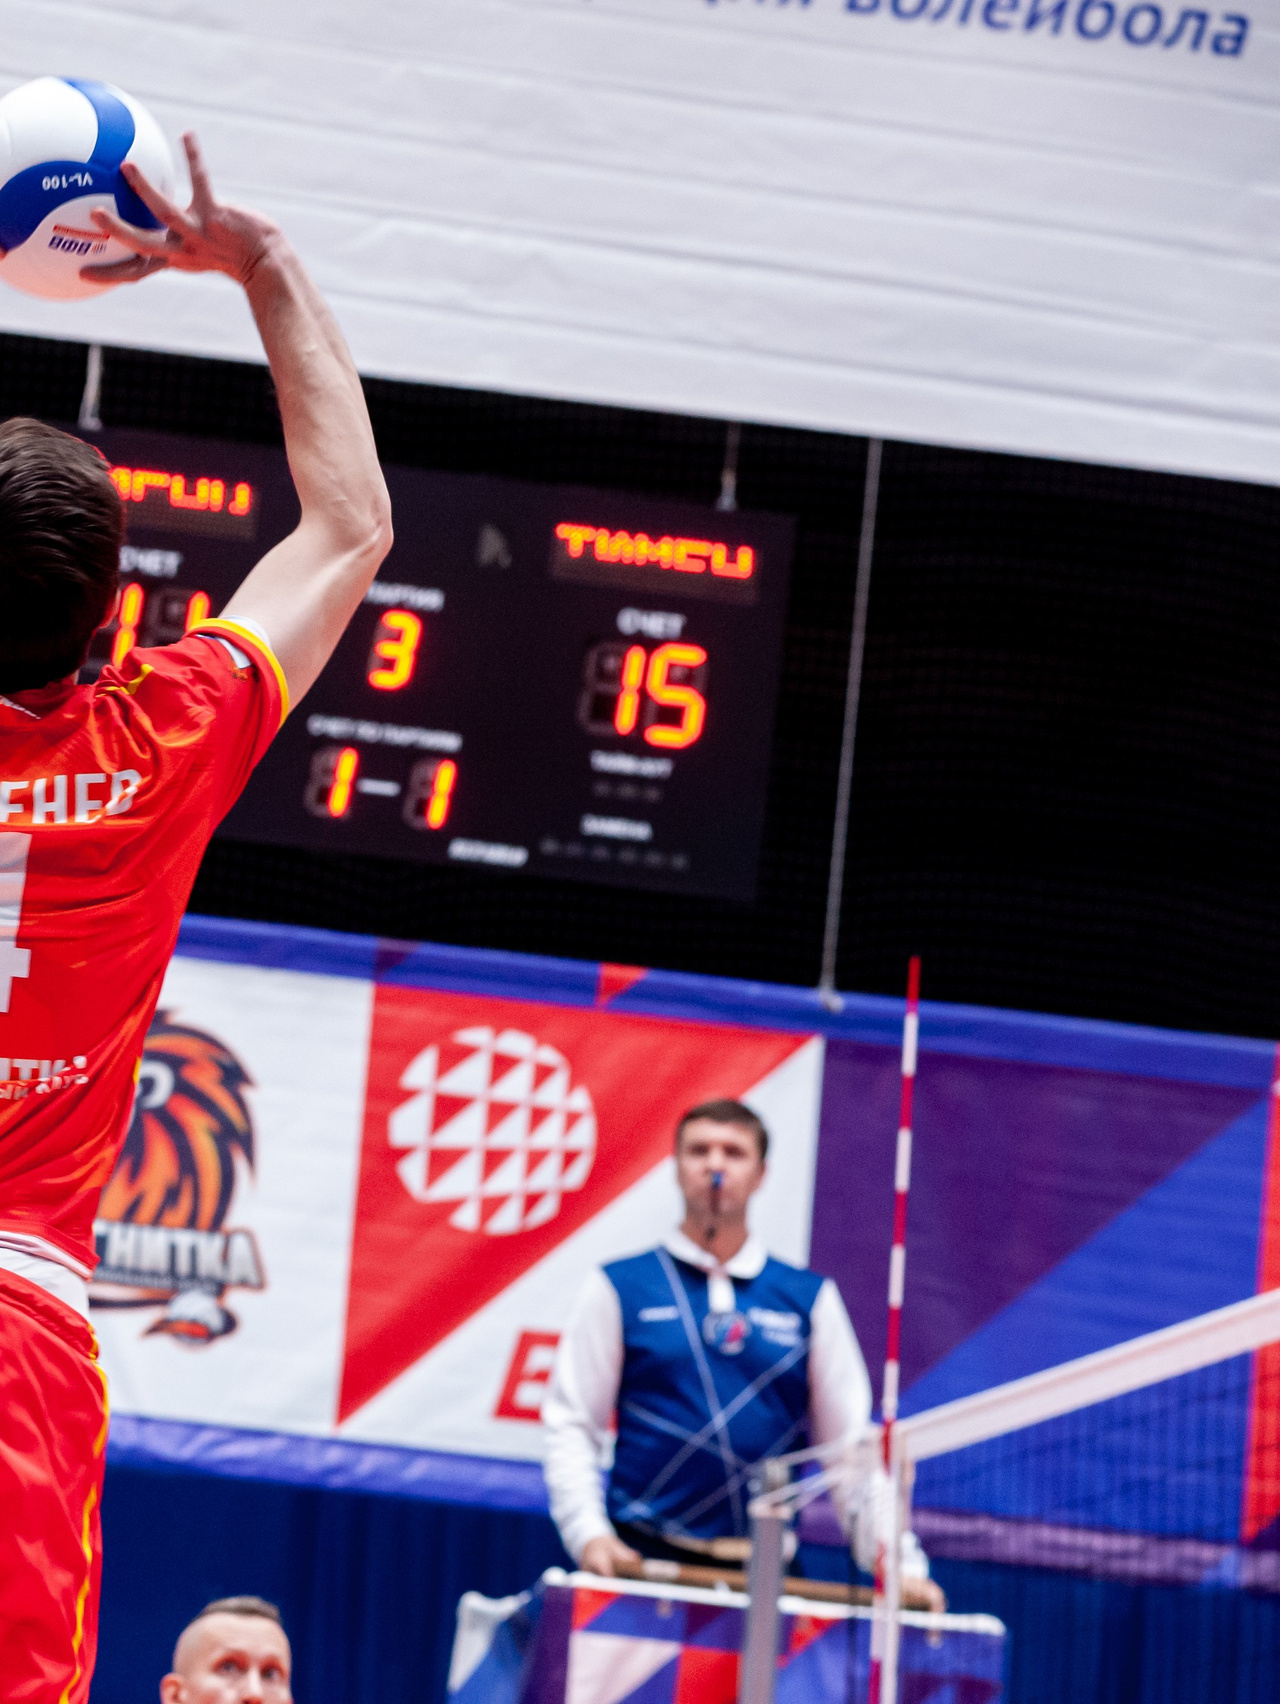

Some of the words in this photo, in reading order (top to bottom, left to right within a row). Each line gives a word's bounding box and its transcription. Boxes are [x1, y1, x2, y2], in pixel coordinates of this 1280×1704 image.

[42, 172, 93, 191] VL-100
[367, 608, 423, 692] 3
[614, 642, 708, 749] 15
[93, 1219, 261, 1287] НИТКА
